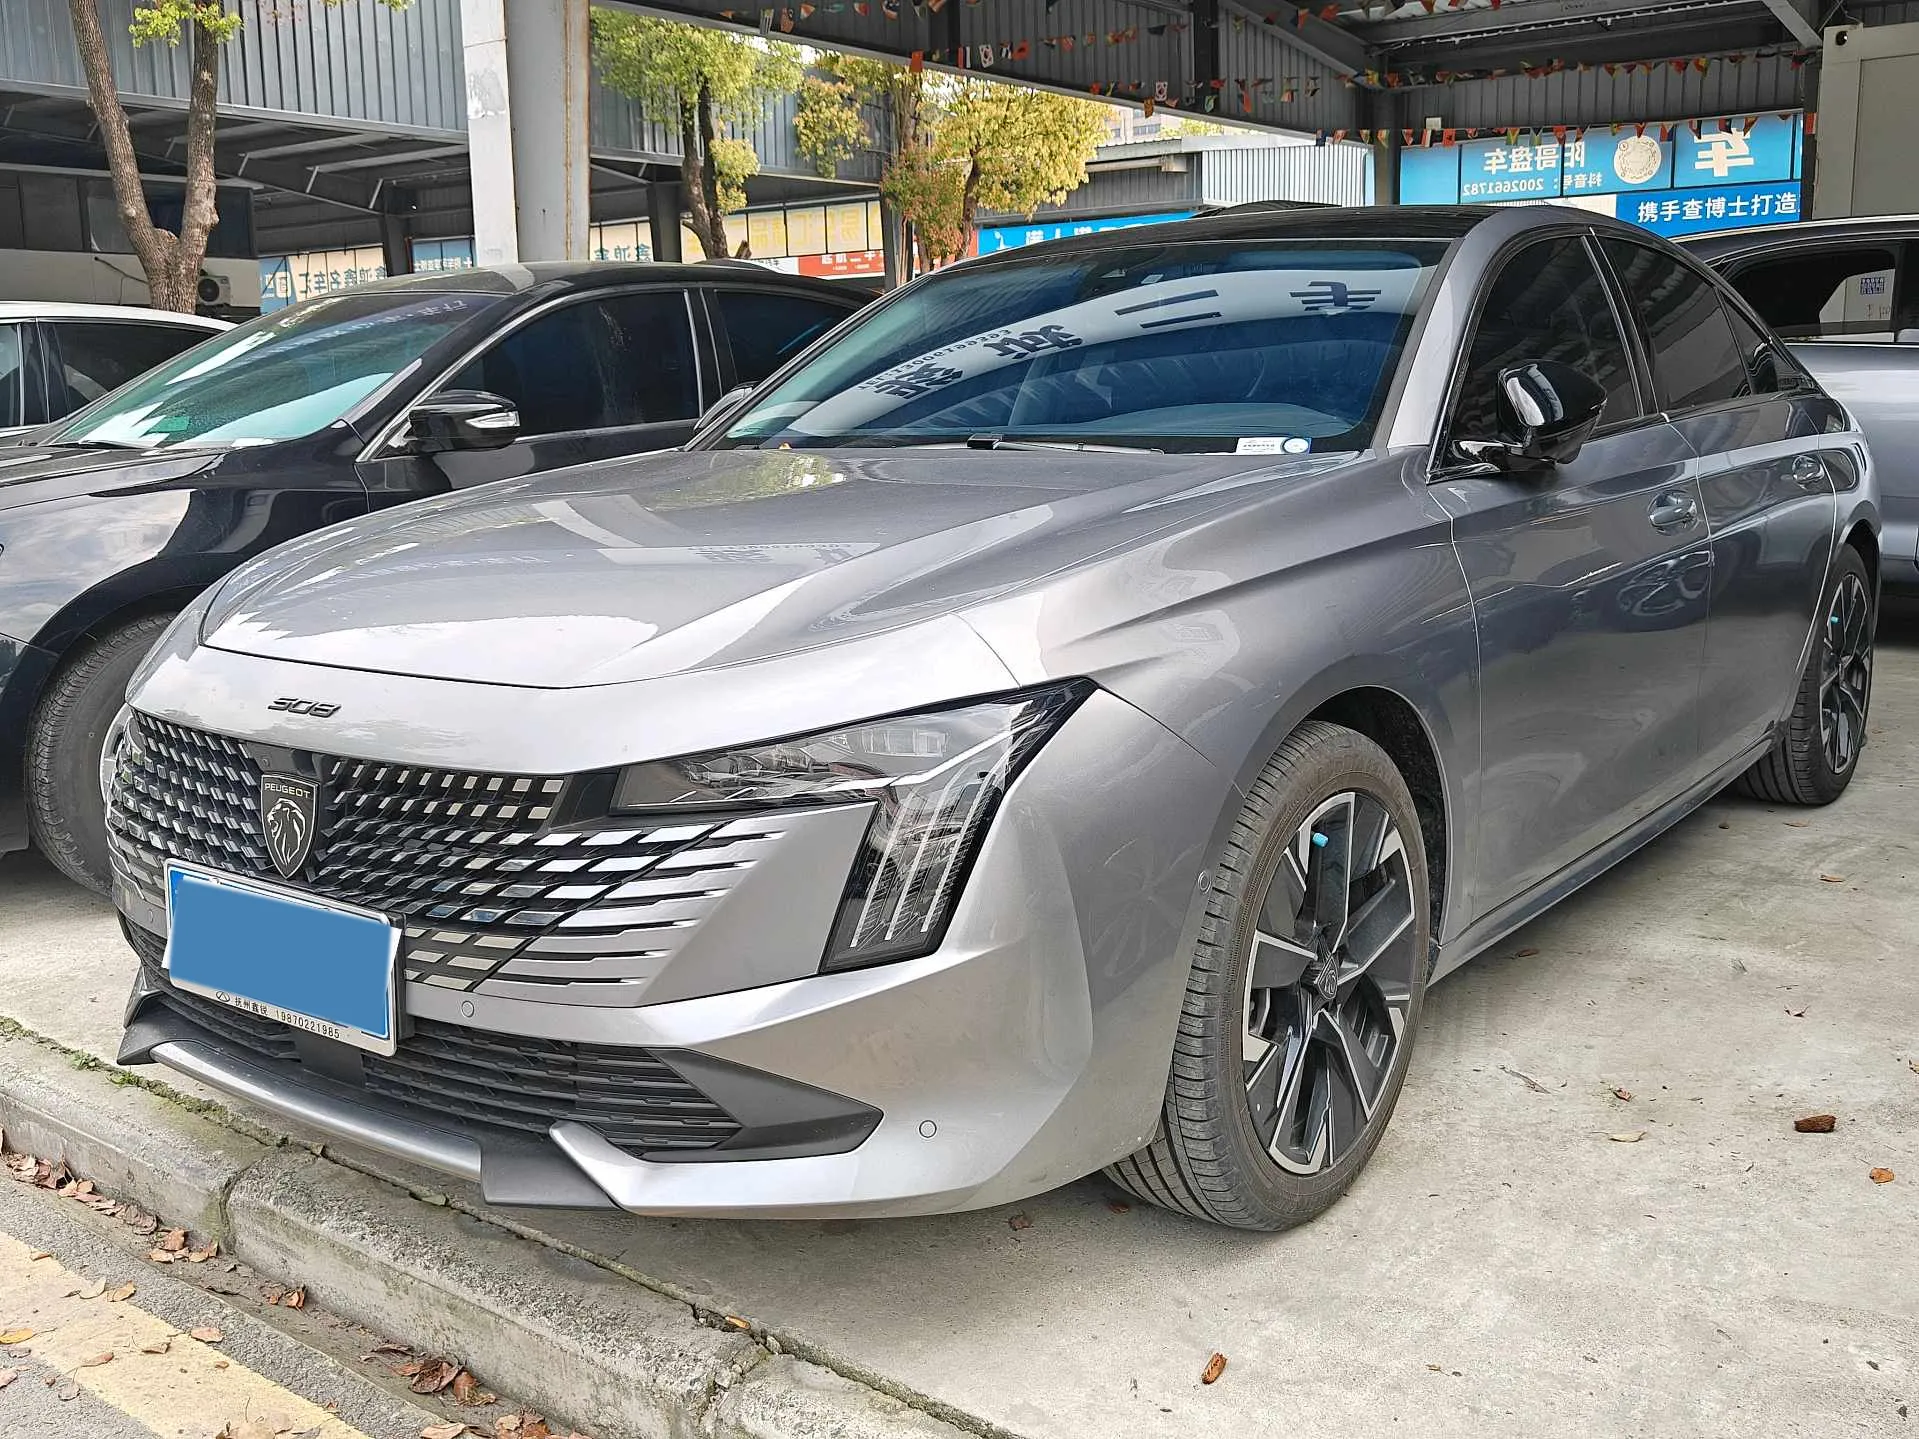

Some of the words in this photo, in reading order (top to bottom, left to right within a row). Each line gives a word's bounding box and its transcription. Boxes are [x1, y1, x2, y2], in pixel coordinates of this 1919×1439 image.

[1637, 191, 1800, 224] 携手查博士打造
[267, 697, 342, 718] 508
[264, 783, 311, 799] PEUGEOT
[275, 1010, 340, 1039] 19870221985
